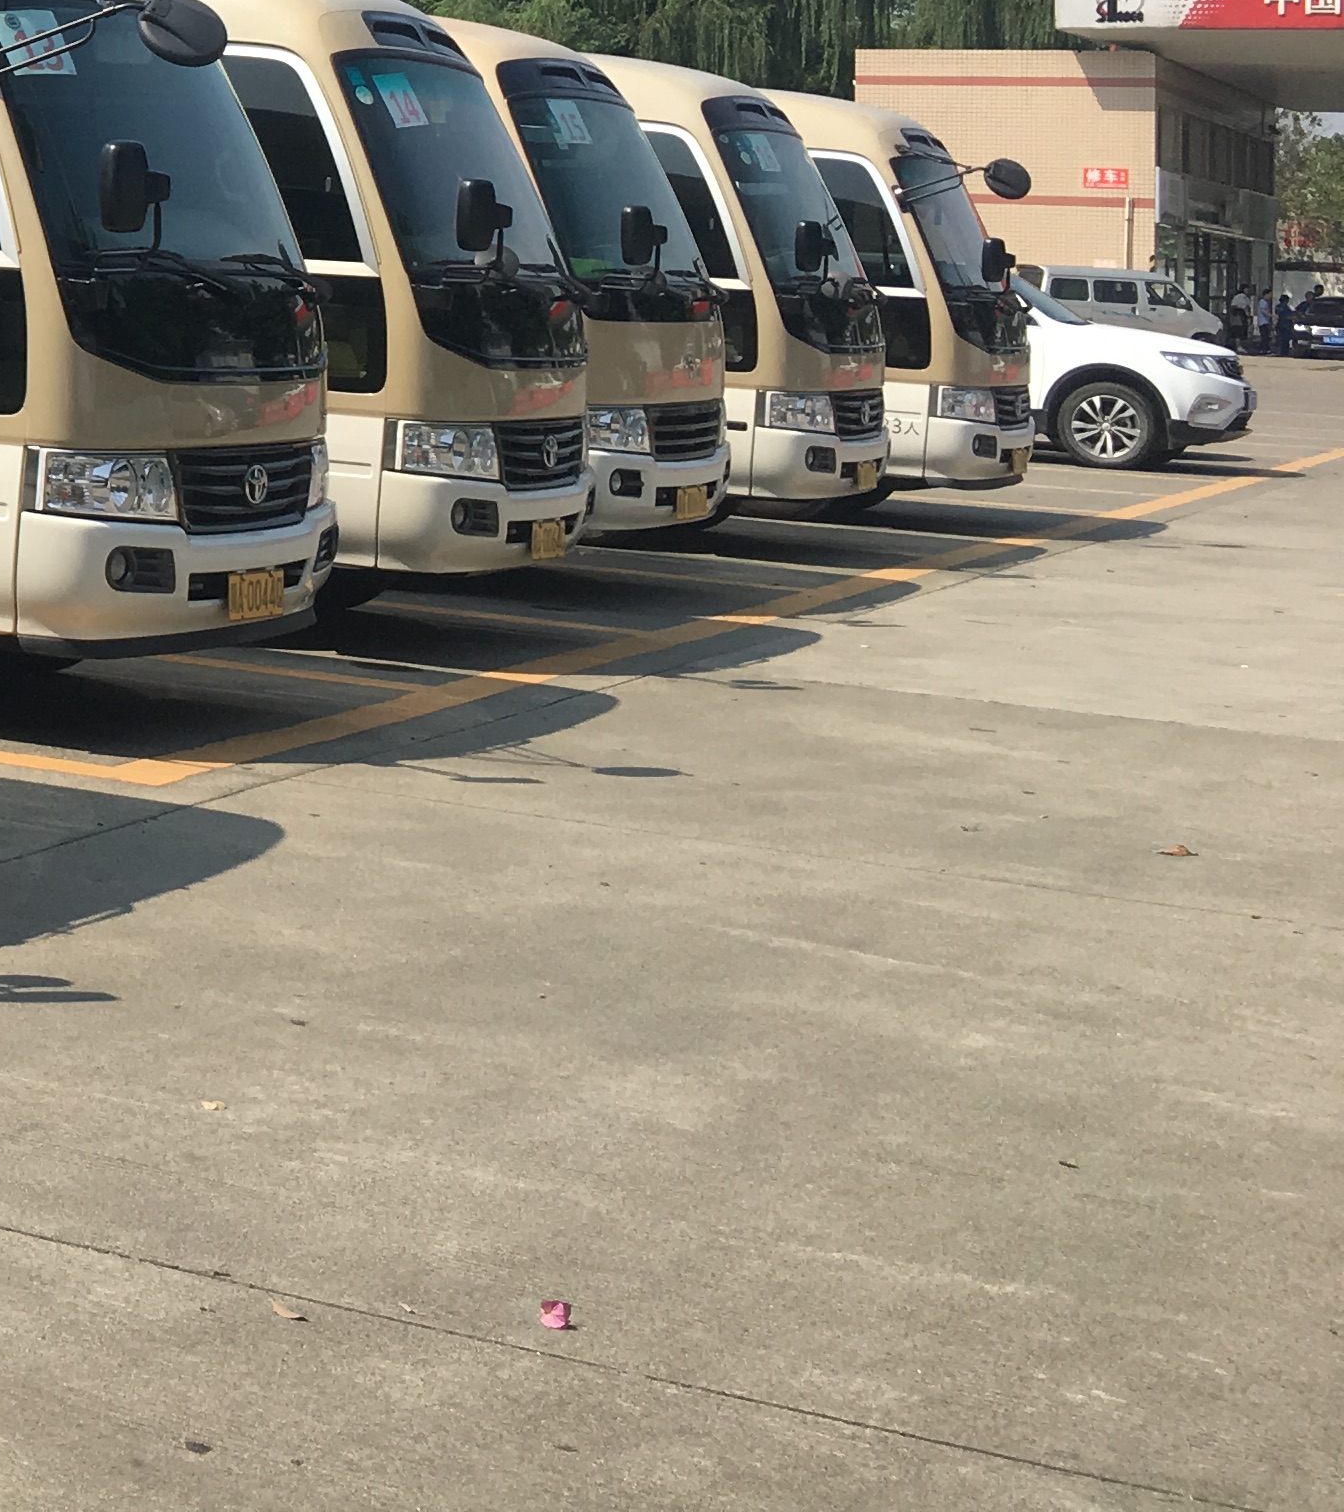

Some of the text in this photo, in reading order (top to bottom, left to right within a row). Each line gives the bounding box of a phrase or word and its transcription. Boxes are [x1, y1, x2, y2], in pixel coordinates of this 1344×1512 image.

[15, 30, 64, 71] 13
[390, 90, 421, 123] 14
[560, 113, 586, 141] 15
